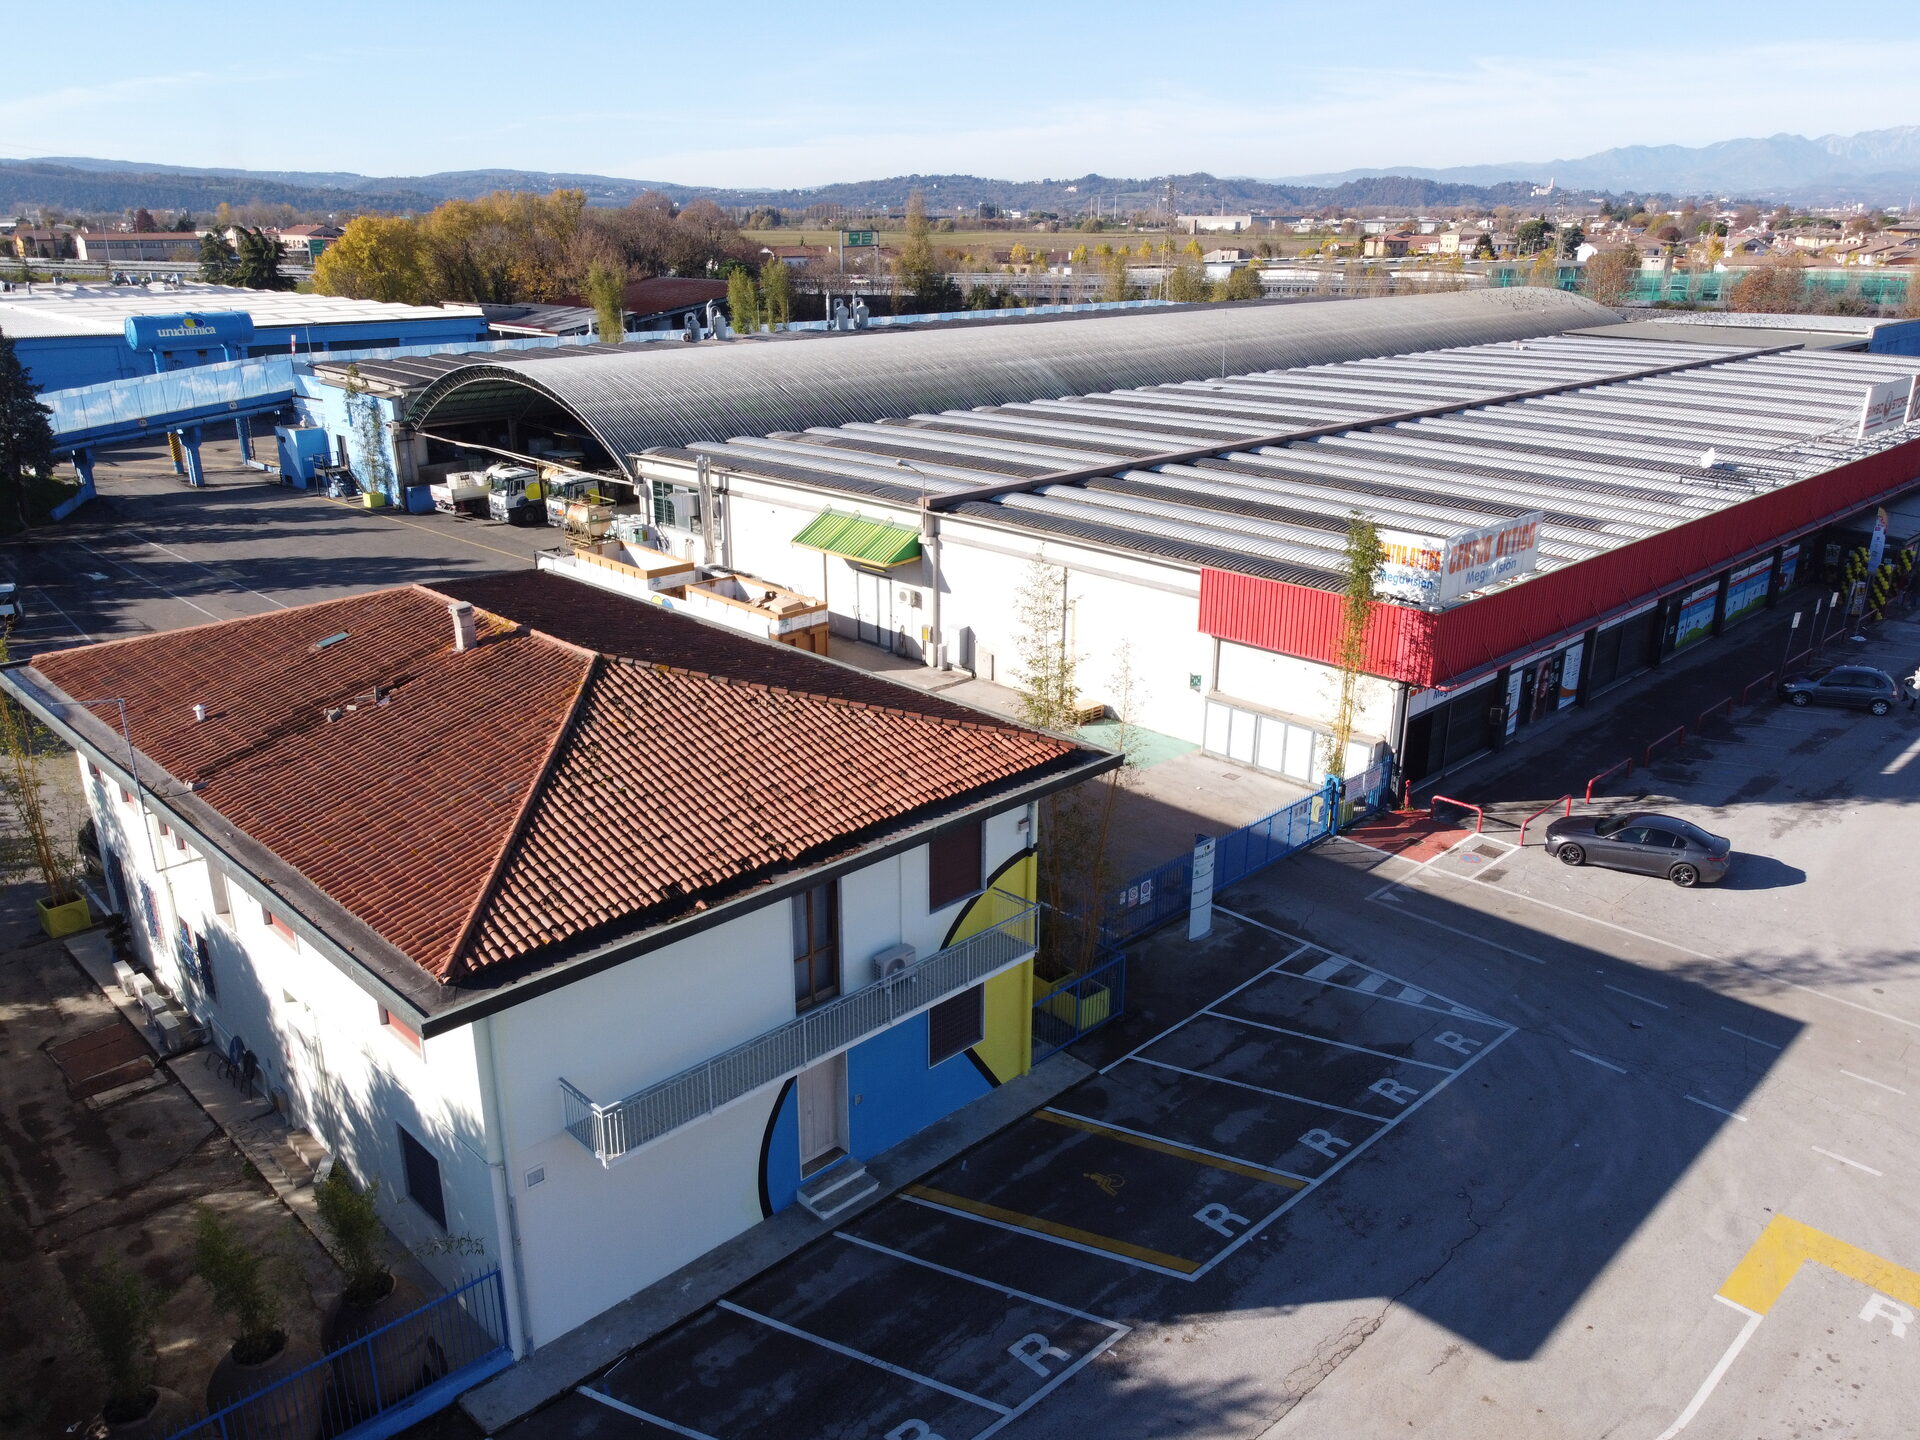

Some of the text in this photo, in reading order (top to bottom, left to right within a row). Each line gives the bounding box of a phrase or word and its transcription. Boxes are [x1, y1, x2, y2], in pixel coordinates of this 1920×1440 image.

[157, 325, 216, 337] unichimica
[1410, 547, 1441, 573] OTTICO
[1448, 521, 1537, 575] CENTRO OTTICO
[1465, 557, 1517, 585] Megavision
[1434, 1030, 1483, 1055] R
[1367, 1077, 1420, 1105] R
[1297, 1128, 1352, 1158] R
[1192, 1202, 1251, 1238] R
[1858, 1292, 1915, 1339] R
[1007, 1332, 1072, 1378] R
